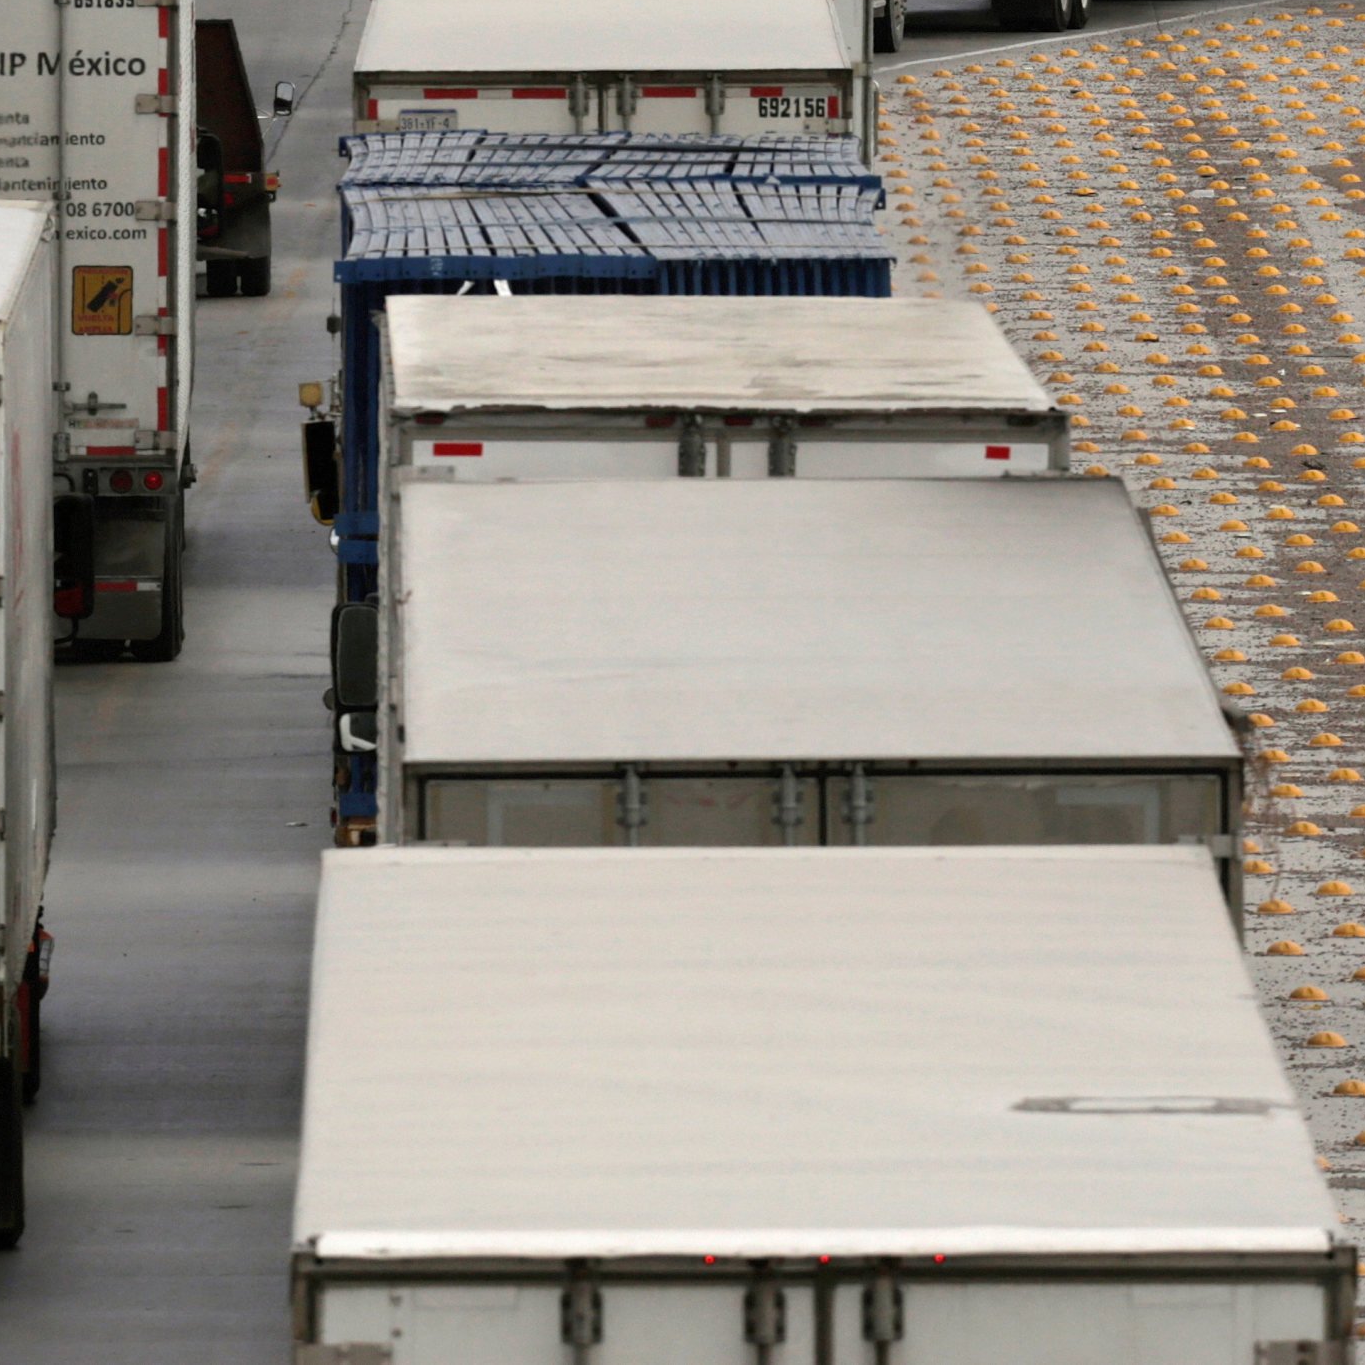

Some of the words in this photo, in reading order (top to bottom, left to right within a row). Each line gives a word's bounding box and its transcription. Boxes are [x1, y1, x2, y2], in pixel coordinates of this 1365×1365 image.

[37, 49, 146, 76] México
[757, 97, 826, 118] 692156
[92, 202, 135, 218] 6700
